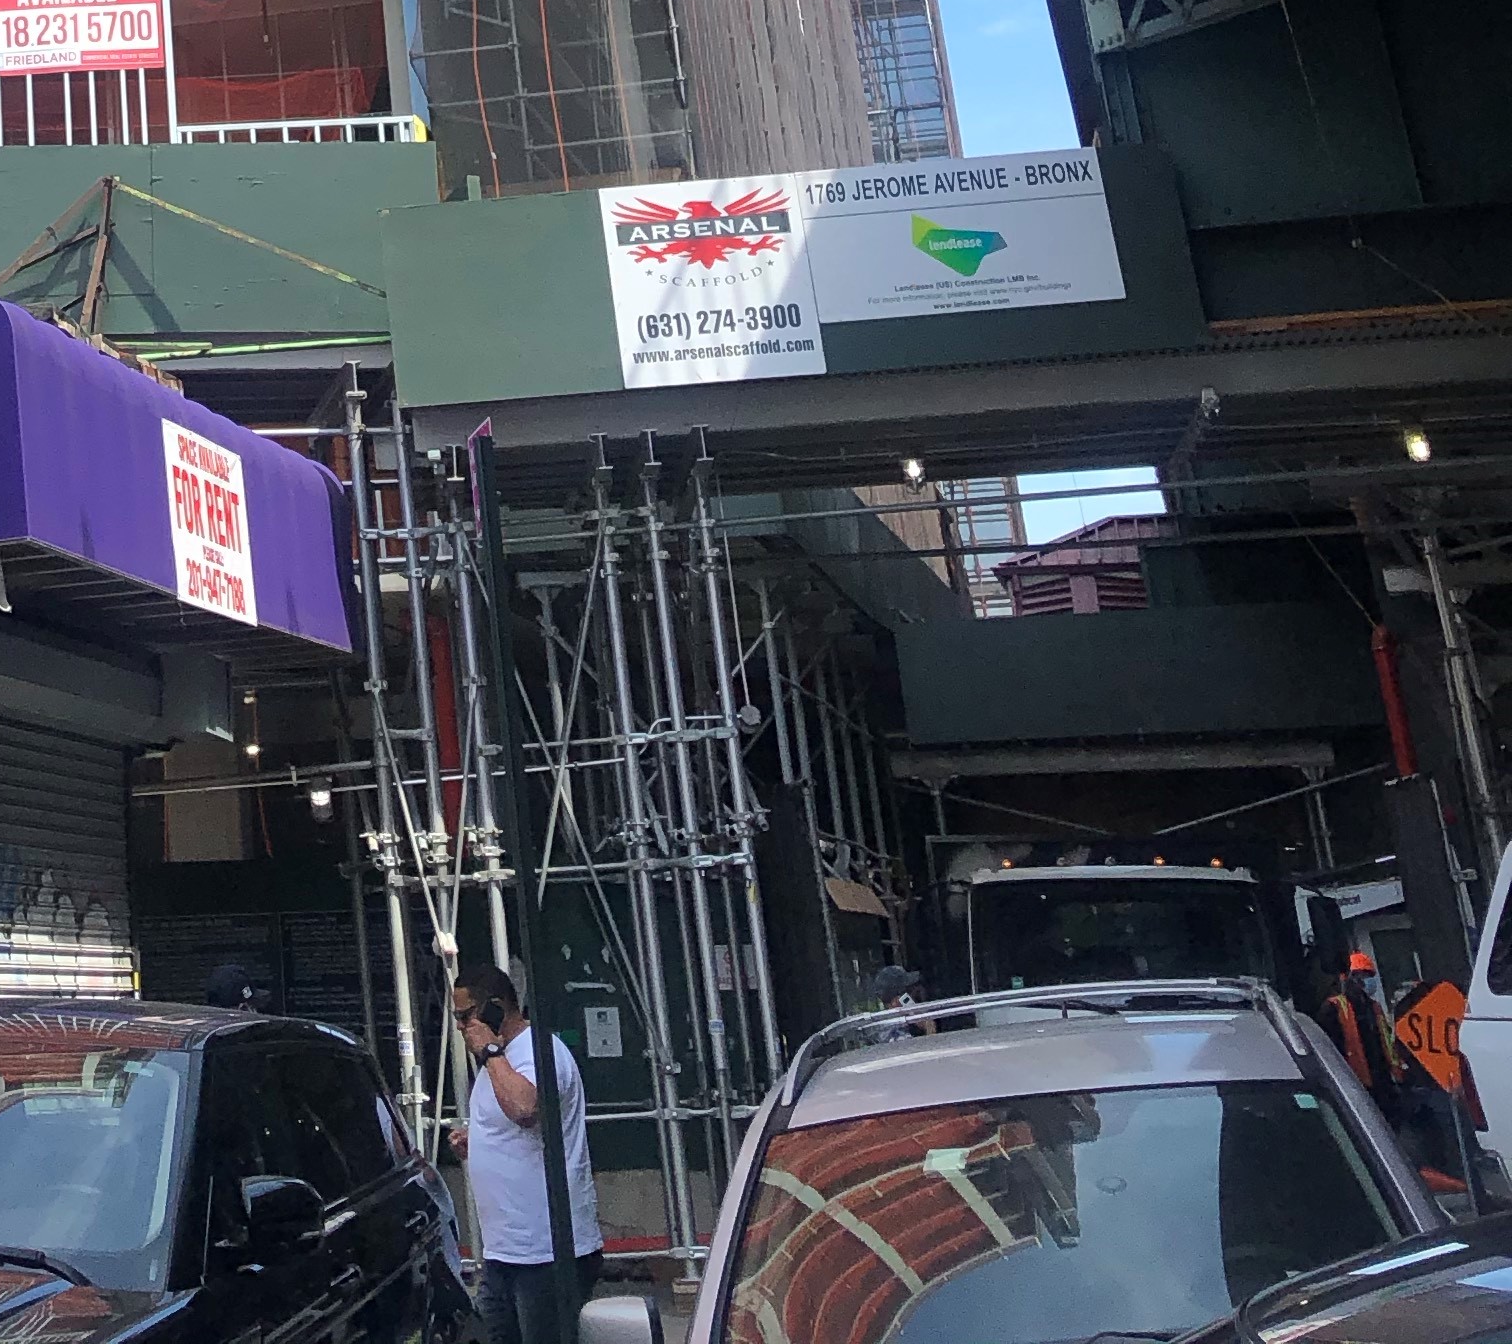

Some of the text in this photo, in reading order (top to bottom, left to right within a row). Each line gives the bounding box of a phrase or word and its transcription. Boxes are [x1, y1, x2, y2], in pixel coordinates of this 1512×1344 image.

[87, 9, 153, 42] 5700
[5, 51, 78, 66] FRIEDLAND
[805, 181, 846, 205] 1769
[852, 174, 929, 201] JEROME
[934, 167, 1008, 194] AVENUE
[1024, 160, 1094, 186] BRONX
[629, 215, 780, 242] ARSENAL
[658, 265, 763, 288] SCAFFOLD
[637, 303, 802, 344] (631) 274-3900
[632, 338, 815, 365] www.arsenalscaffold.com
[172, 464, 243, 554] FOR RENT
